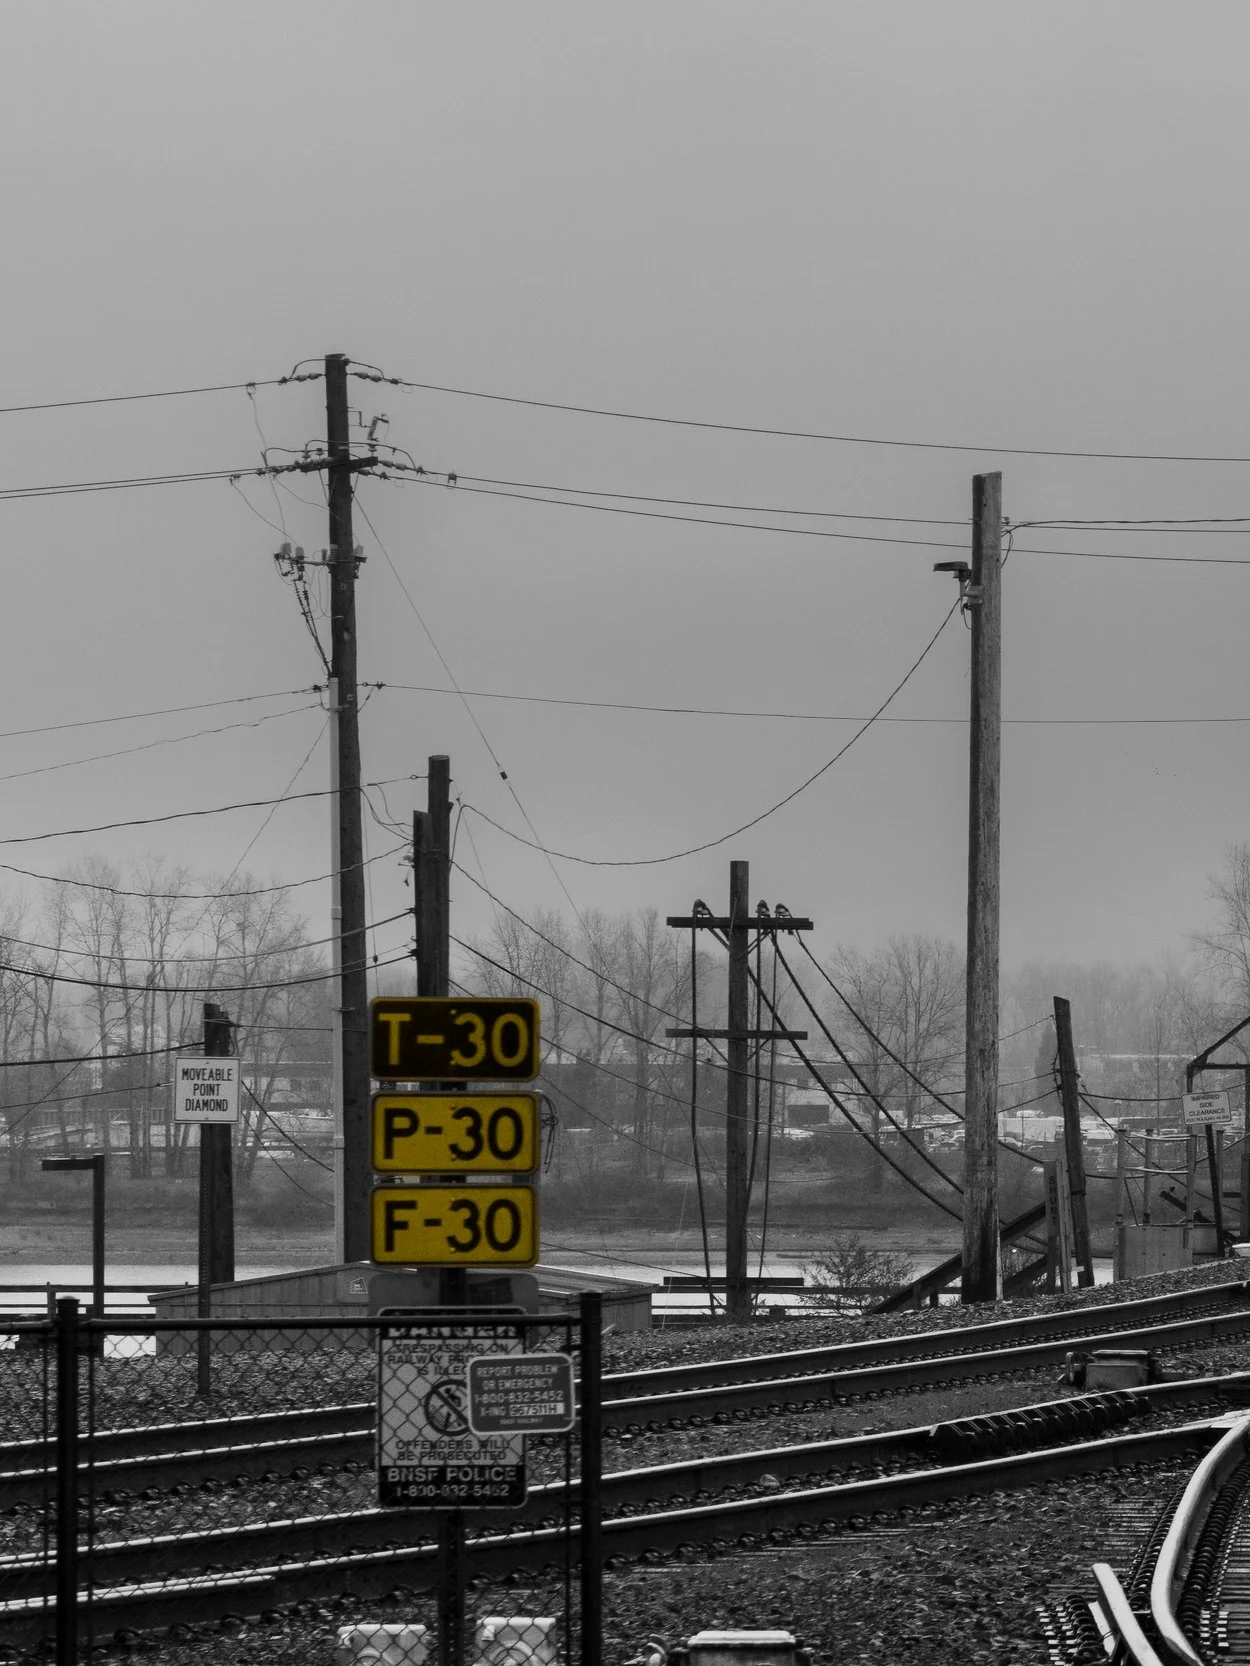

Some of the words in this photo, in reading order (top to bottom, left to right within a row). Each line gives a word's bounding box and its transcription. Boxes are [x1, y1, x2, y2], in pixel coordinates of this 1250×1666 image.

[378, 1012, 529, 1068] T-30
[181, 1067, 233, 1081] MOVEABLE
[193, 1083, 221, 1097] POINT
[185, 1098, 228, 1112] DIAMOND
[1188, 1108, 1225, 1117] CLEARANCE
[382, 1106, 524, 1161] P-30
[384, 1198, 522, 1253] F-30
[395, 1343, 485, 1353] TRESPASSING
[490, 1343, 509, 1353] ON
[476, 1366, 512, 1377] REPORT
[514, 1364, 558, 1375] PROBLEM
[482, 1380, 496, 1390] OR
[498, 1378, 553, 1390] EMERGENCY
[474, 1390, 563, 1404] 1-800-832-5452
[395, 1440, 473, 1450] OFFENDERS
[480, 1439, 511, 1450] WILL
[398, 1450, 414, 1461] BE
[419, 1450, 507, 1461] PROSECUTED
[387, 1467, 439, 1482] BNSF
[446, 1467, 517, 1482] POLICE
[396, 1484, 510, 1497] 1-800-832-5452
